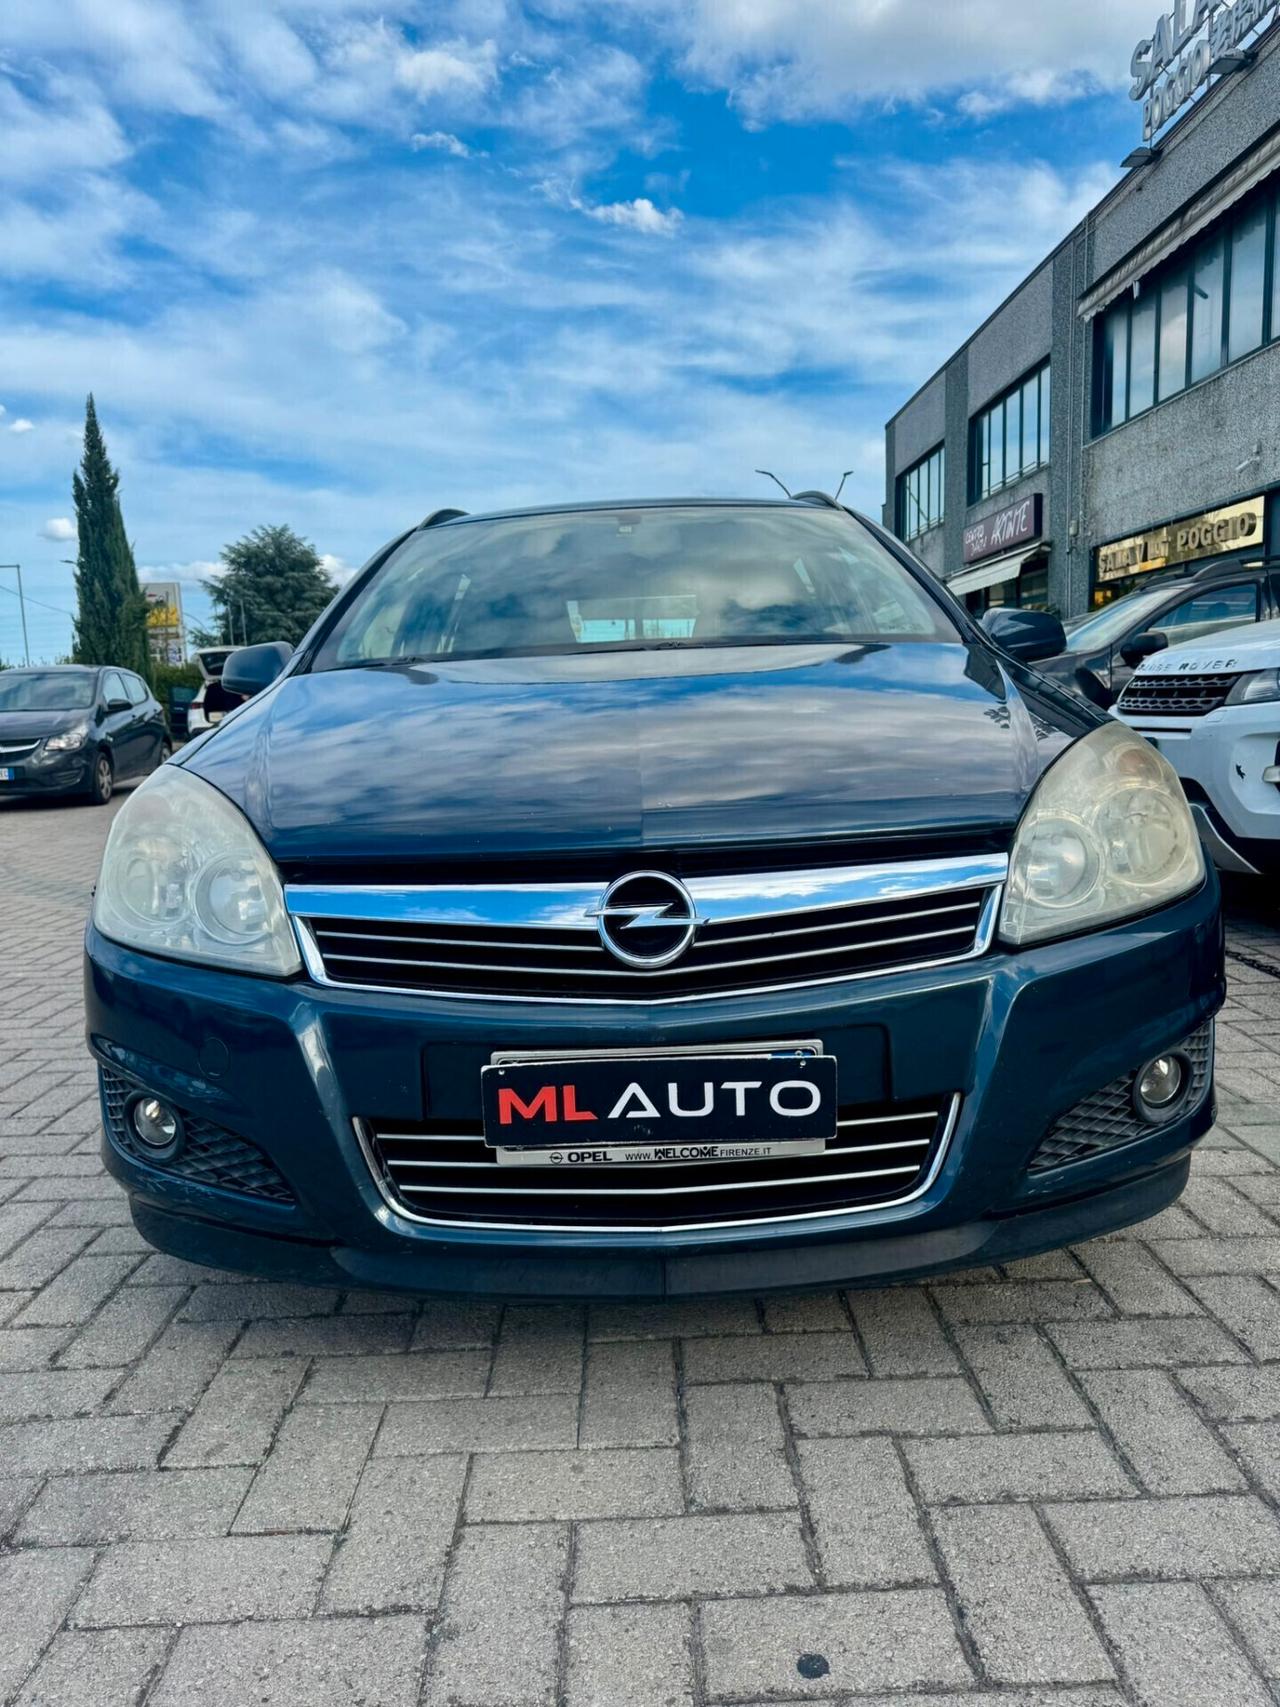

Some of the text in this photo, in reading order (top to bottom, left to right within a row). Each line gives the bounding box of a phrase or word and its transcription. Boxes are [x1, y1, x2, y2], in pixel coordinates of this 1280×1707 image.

[1177, 512, 1257, 552] POGGIO
[498, 1080, 822, 1125] ML AUTO
[567, 1151, 613, 1163] OPEL
